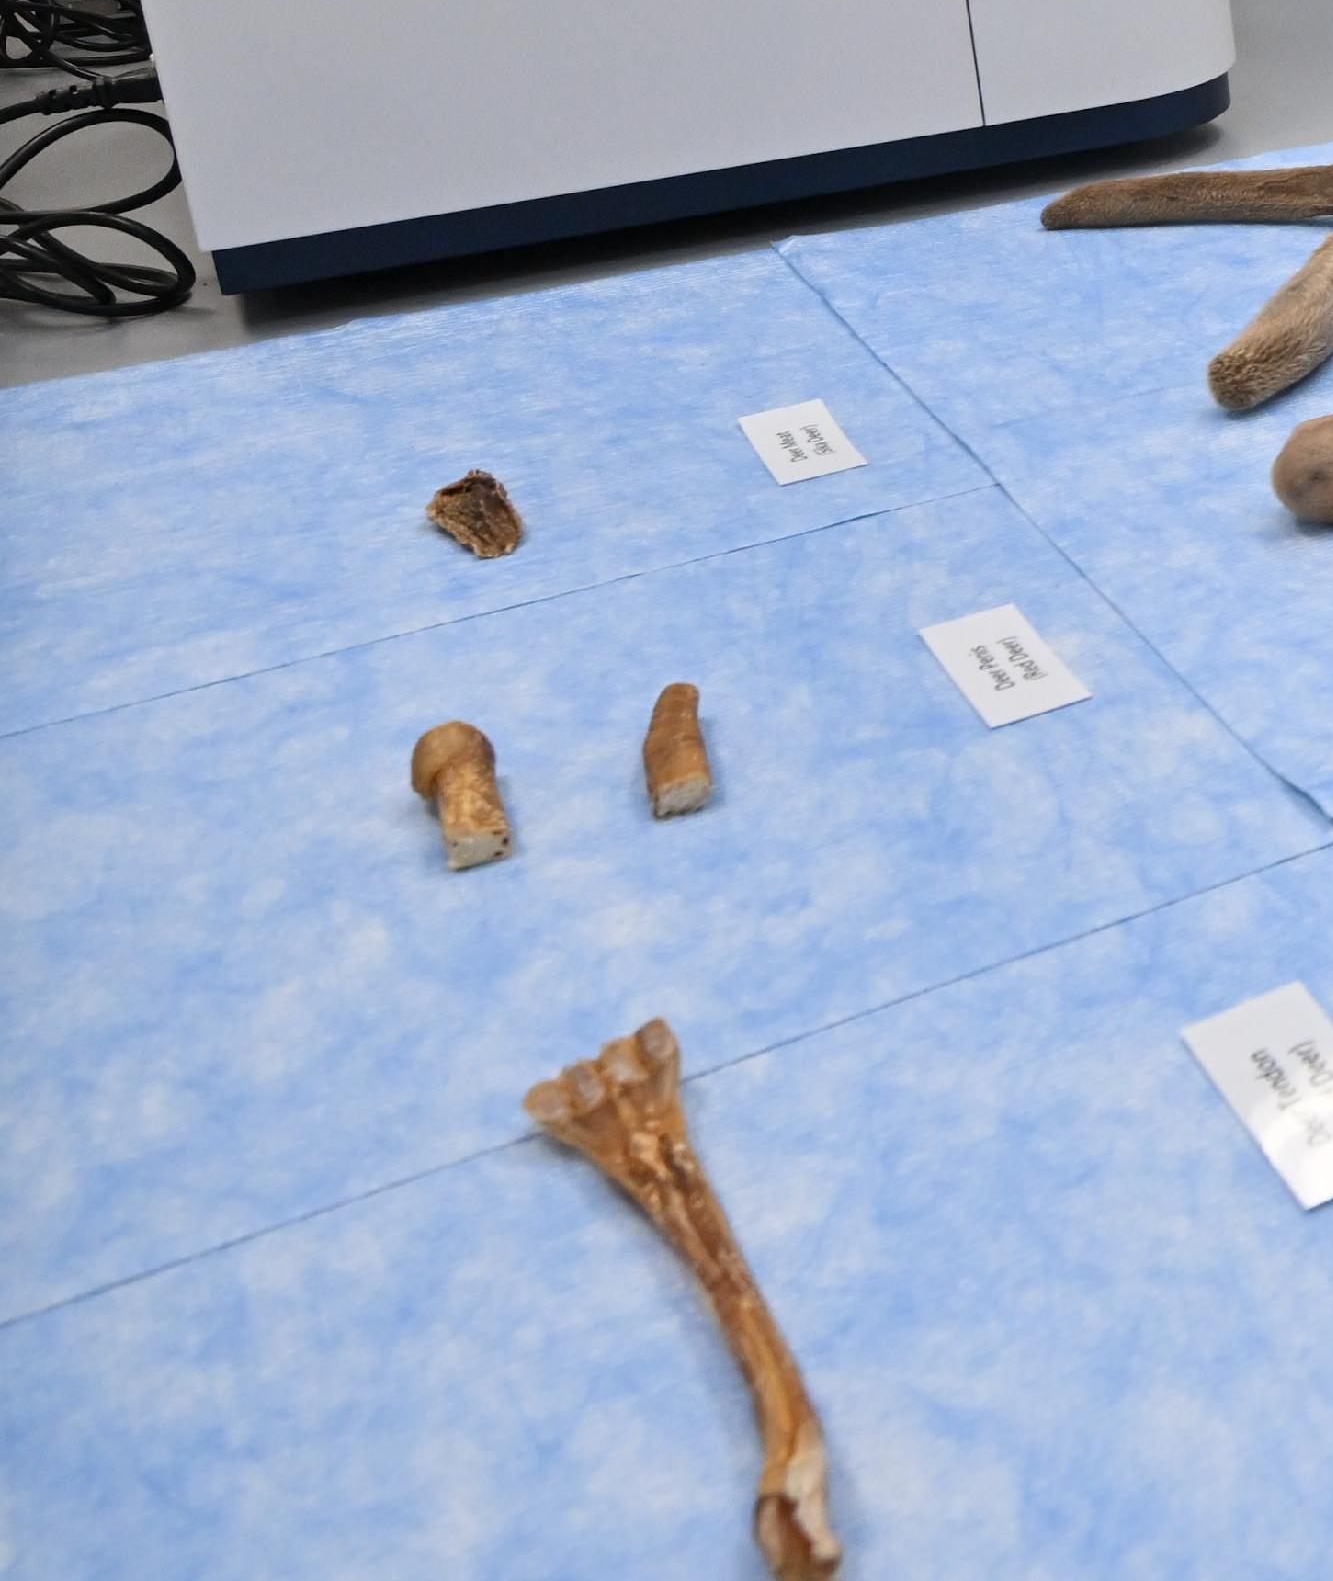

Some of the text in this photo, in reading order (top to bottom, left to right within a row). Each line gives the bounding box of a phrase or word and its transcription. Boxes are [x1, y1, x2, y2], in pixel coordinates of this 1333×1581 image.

[970, 644, 1015, 692] Deer Penis
[1250, 1046, 1302, 1112] Tendon
